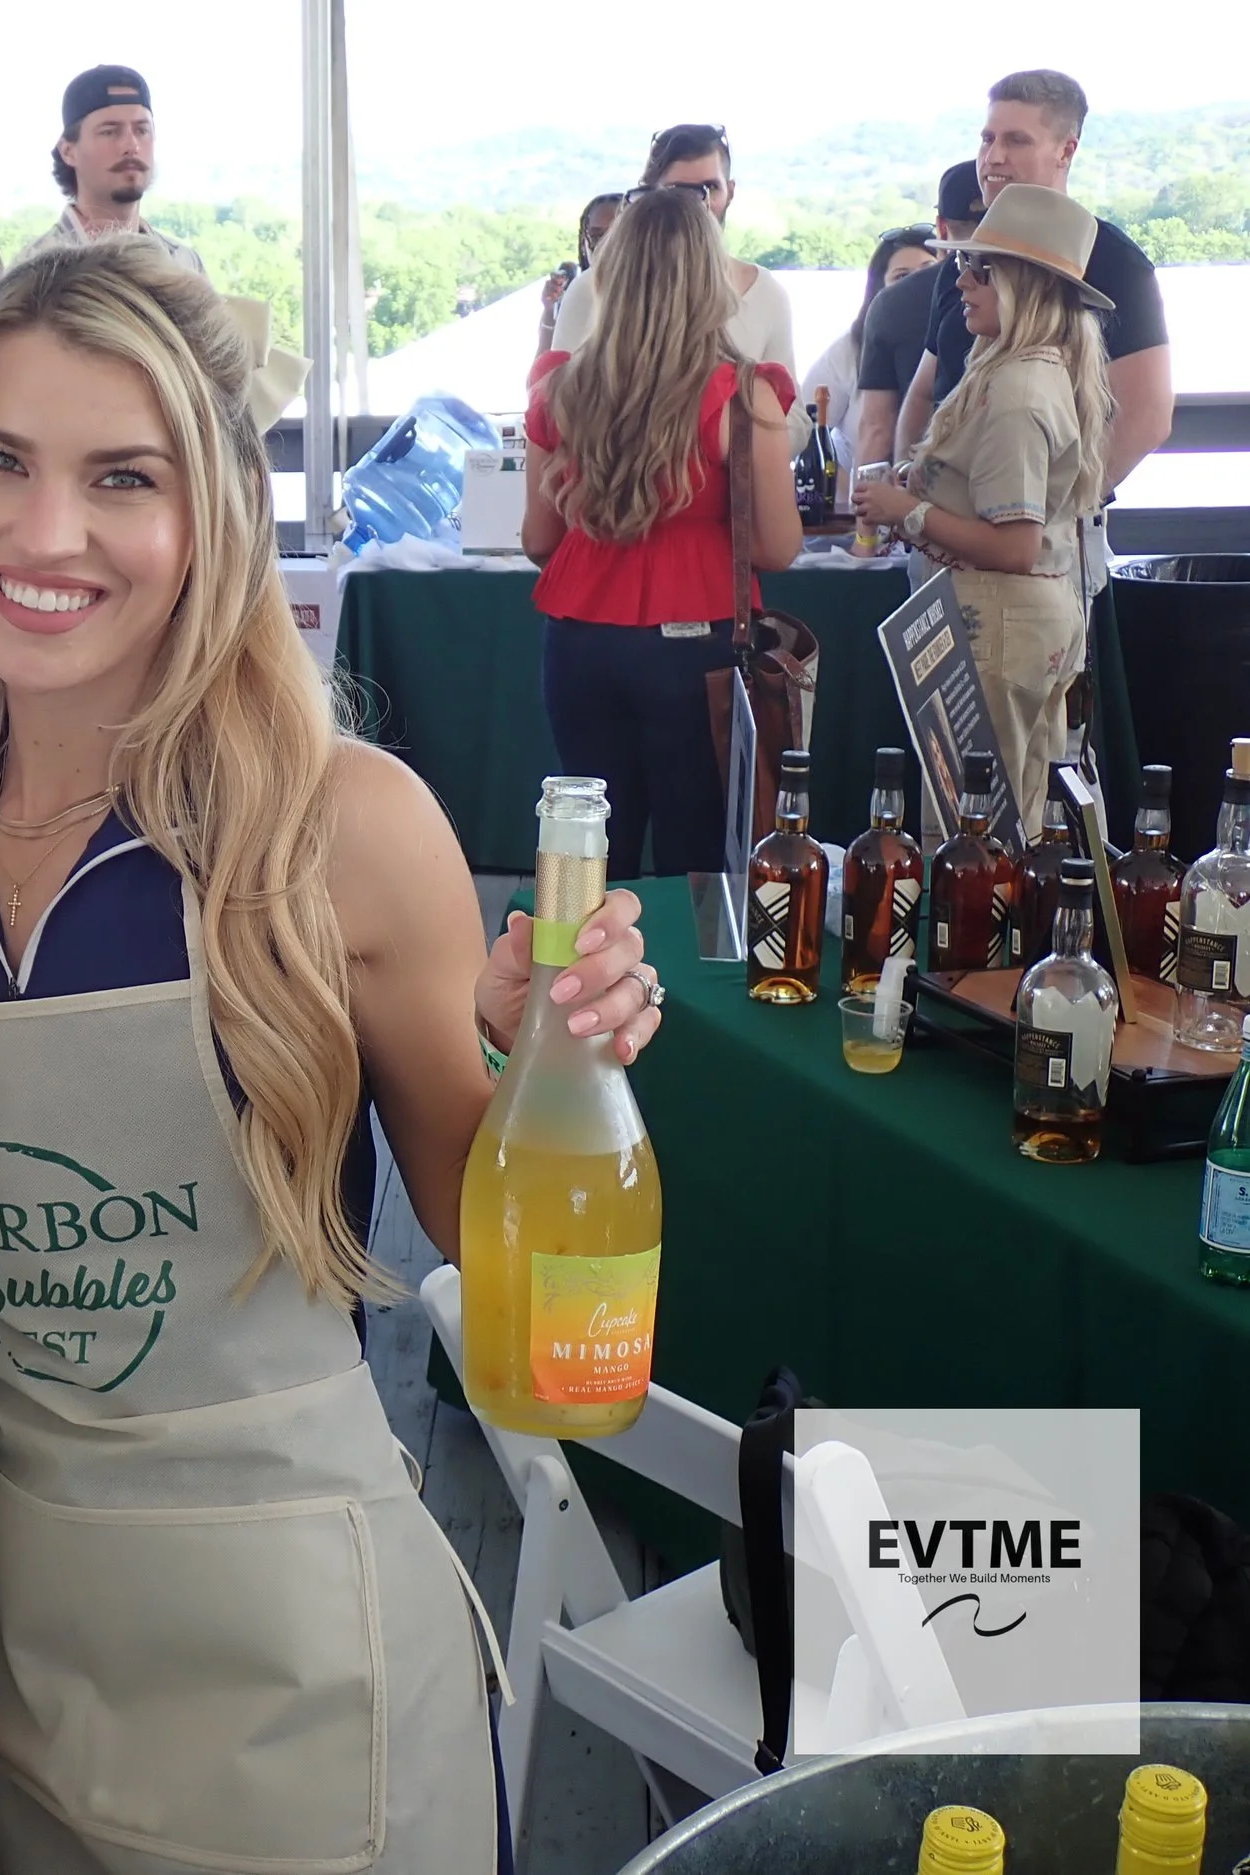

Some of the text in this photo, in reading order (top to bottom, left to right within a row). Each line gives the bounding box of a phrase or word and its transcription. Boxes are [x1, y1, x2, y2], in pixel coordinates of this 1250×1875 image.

[588, 1302, 638, 1337] Cupcake
[553, 1333, 651, 1360] MIMOSA
[593, 1363, 629, 1374] MANGO
[595, 1385, 623, 1393] MANGO
